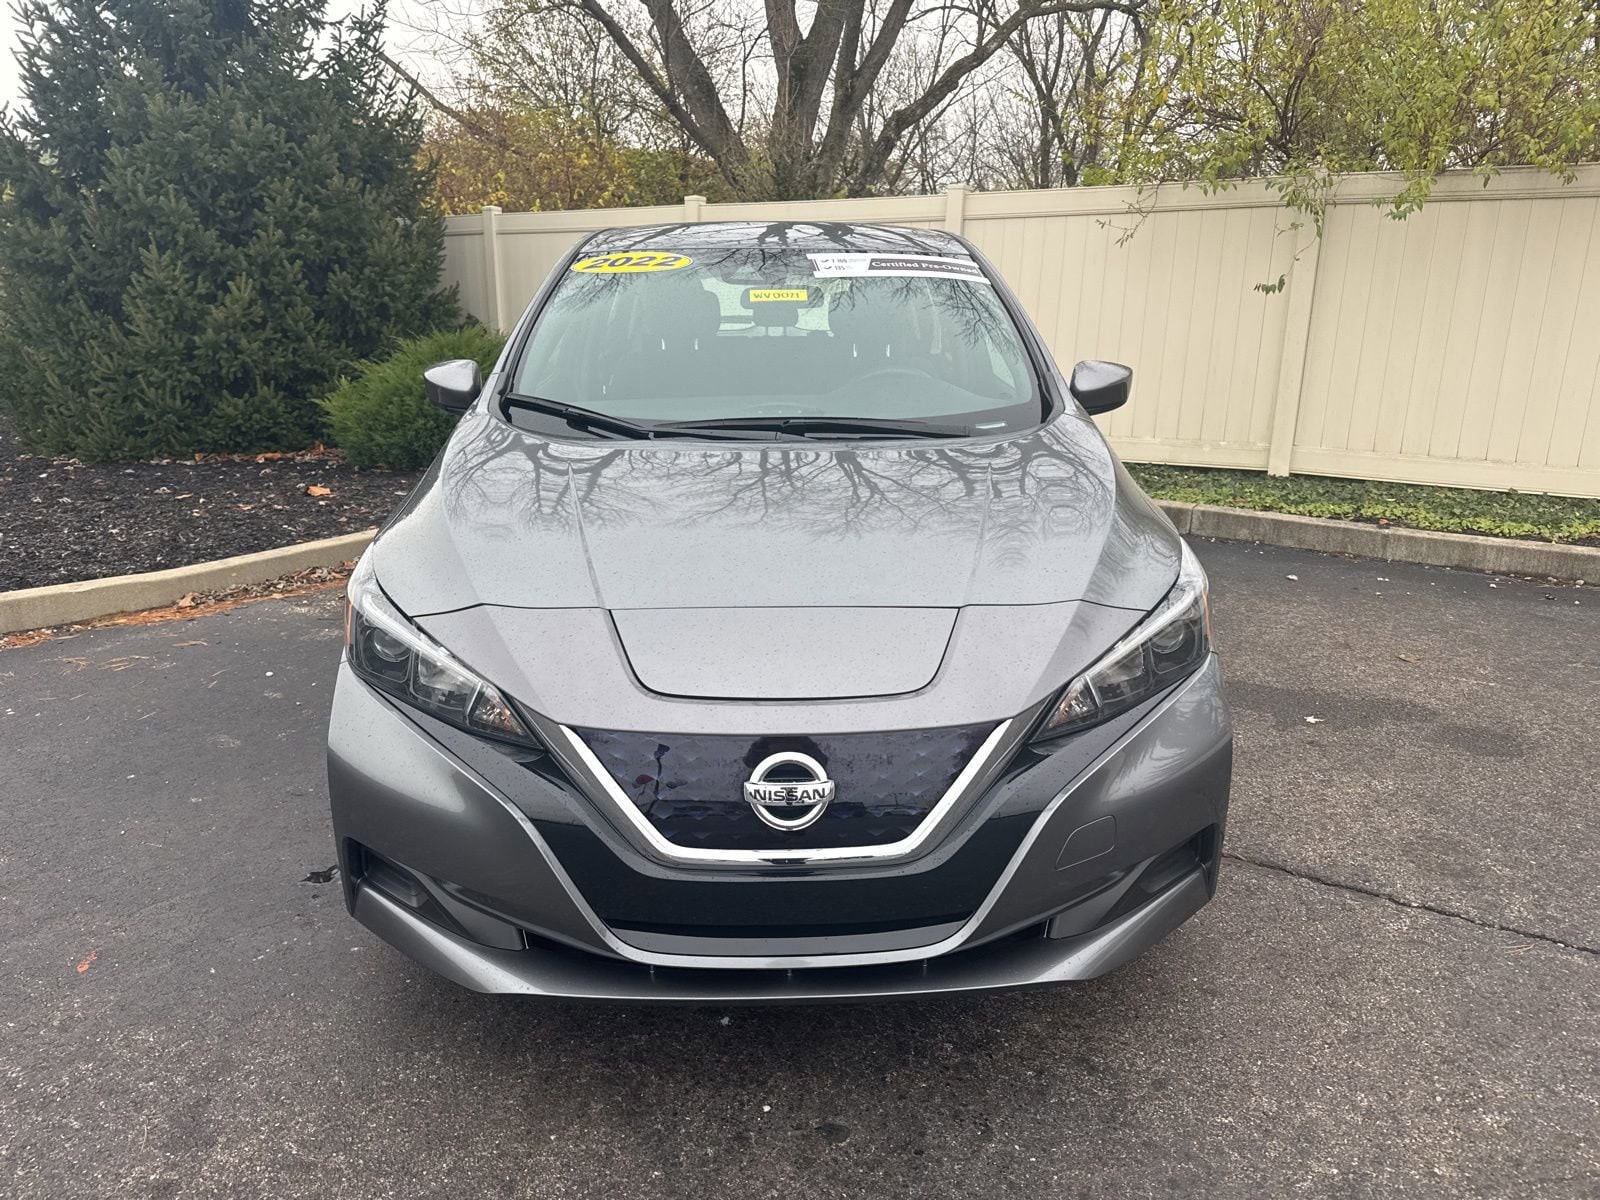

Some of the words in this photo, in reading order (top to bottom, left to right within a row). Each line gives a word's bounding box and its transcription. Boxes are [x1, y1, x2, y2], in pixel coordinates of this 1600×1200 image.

[581, 256, 681, 270] 2022
[871, 261, 919, 269] Certified
[921, 261, 979, 274] Pre-Owned
[752, 788, 826, 801] NISSAN
